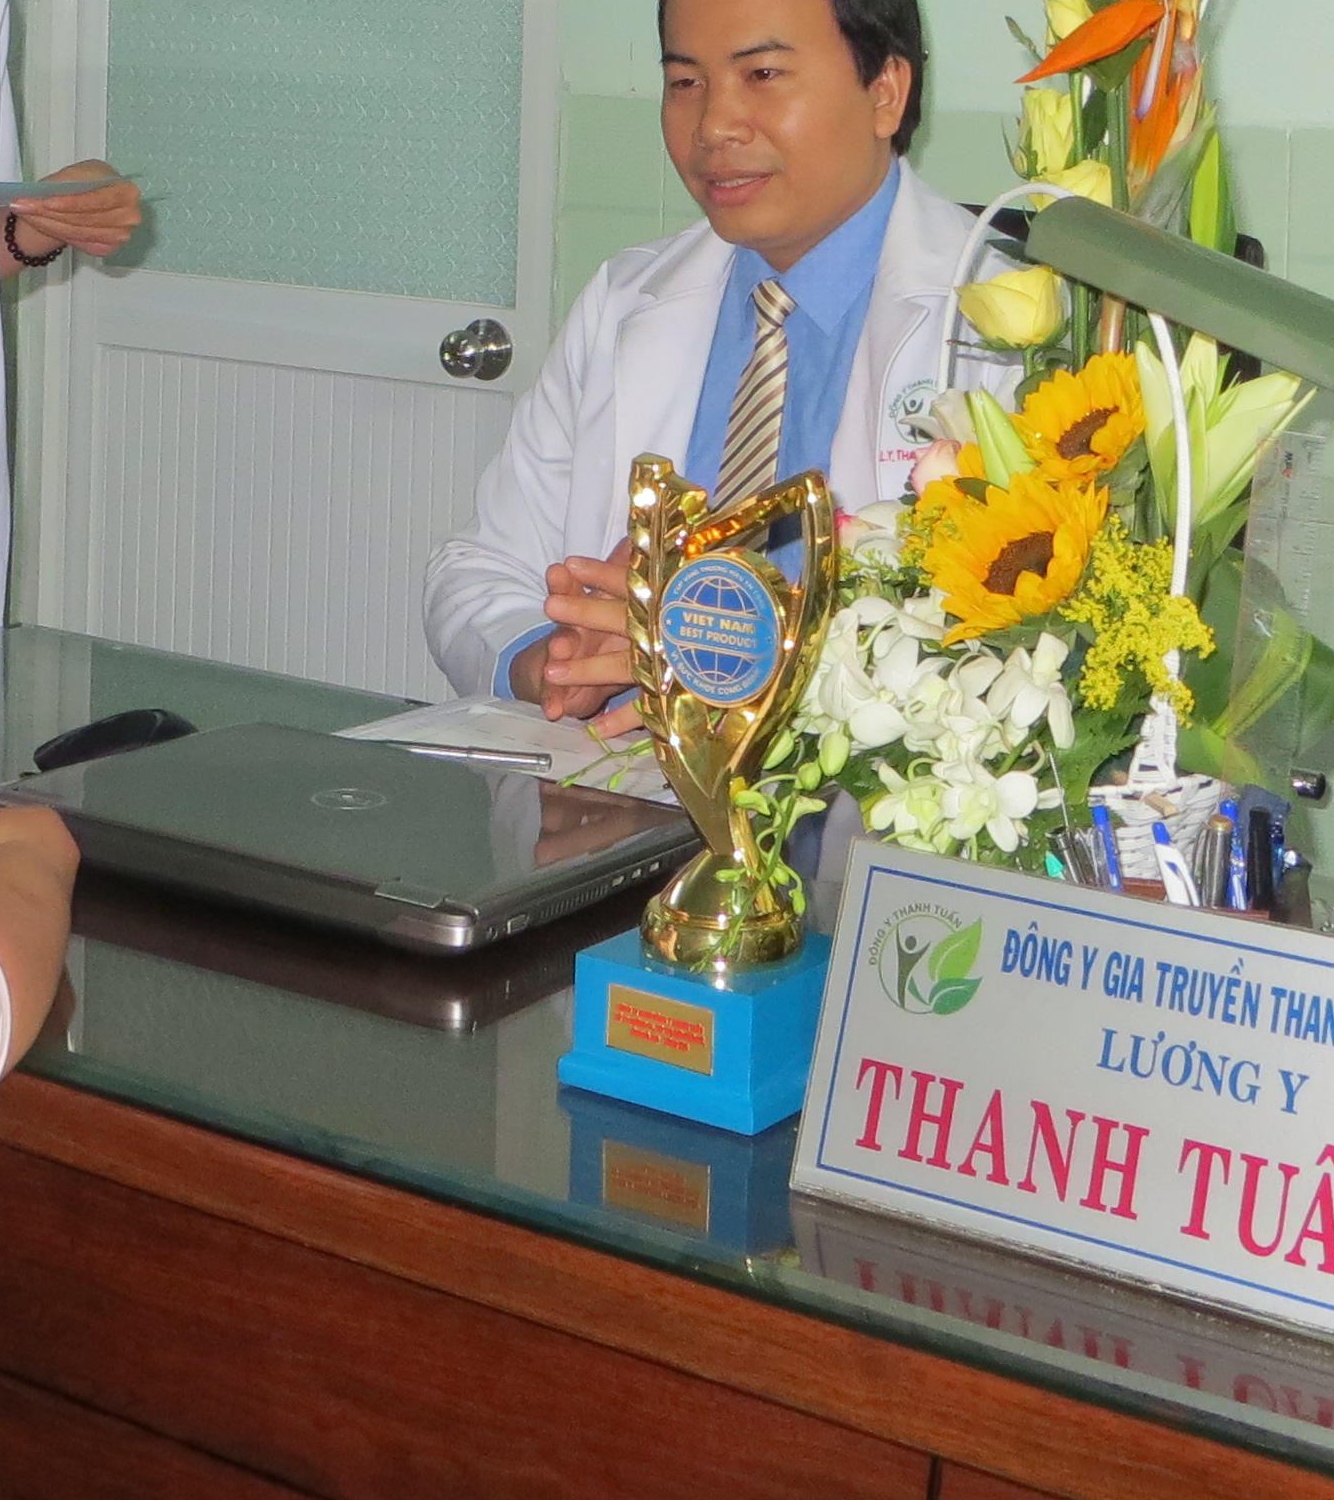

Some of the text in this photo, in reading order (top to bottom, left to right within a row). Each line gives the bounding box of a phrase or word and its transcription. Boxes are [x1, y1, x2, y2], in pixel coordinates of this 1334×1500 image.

[680, 626, 757, 648] BEST PRODUCT
[682, 611, 755, 634] VIET NAM
[883, 917, 892, 927] Y
[893, 902, 931, 920] THANH
[1000, 921, 1073, 986] ĐÔNG
[1080, 945, 1100, 990] Y
[1102, 950, 1145, 1003] GIA
[1155, 957, 1263, 1029] TRUYỀN
[1095, 1027, 1311, 1115] LƯƠNG Y
[855, 1057, 1152, 1221] THANH
